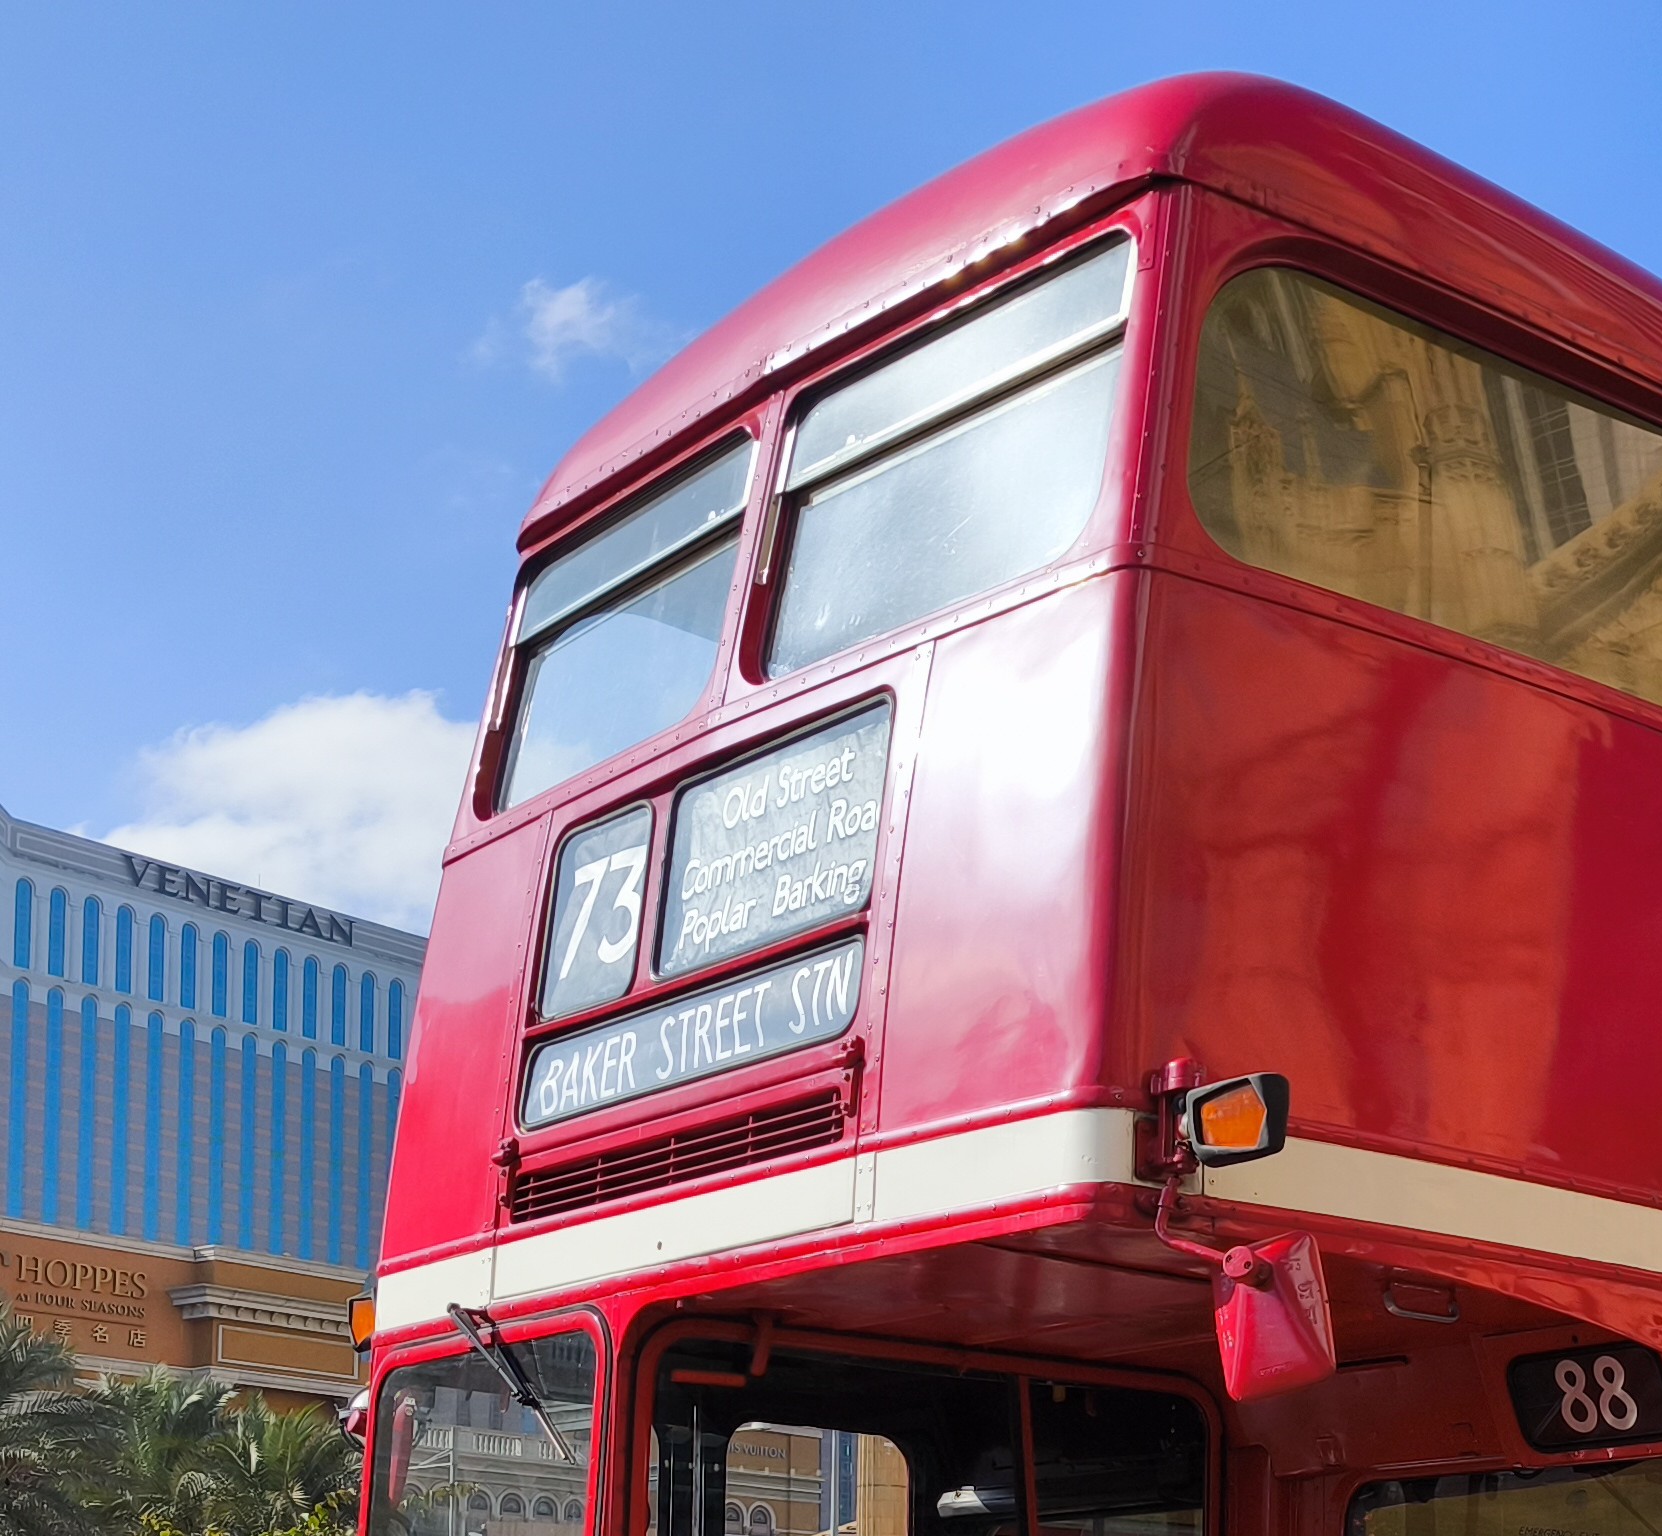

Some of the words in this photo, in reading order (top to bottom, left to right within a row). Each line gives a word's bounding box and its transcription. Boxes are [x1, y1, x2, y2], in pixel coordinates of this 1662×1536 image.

[722, 774, 770, 830] Old
[776, 747, 856, 809] Street
[681, 810, 817, 901] Commercial
[826, 798, 881, 843] Roa
[121, 854, 356, 948] VENETIAN
[559, 844, 649, 981] 73
[679, 896, 757, 953] Poplar
[771, 859, 867, 918] Barking
[539, 1031, 636, 1118] BAKER
[656, 980, 773, 1081] STREET
[788, 948, 855, 1034] STN
[0, 1251, 148, 1299] HOPPES
[36, 1291, 75, 1310] FOUR
[81, 1298, 145, 1319] SEASONS
[1554, 1355, 1638, 1433] 88
[743, 1443, 787, 1459] VUITTON
